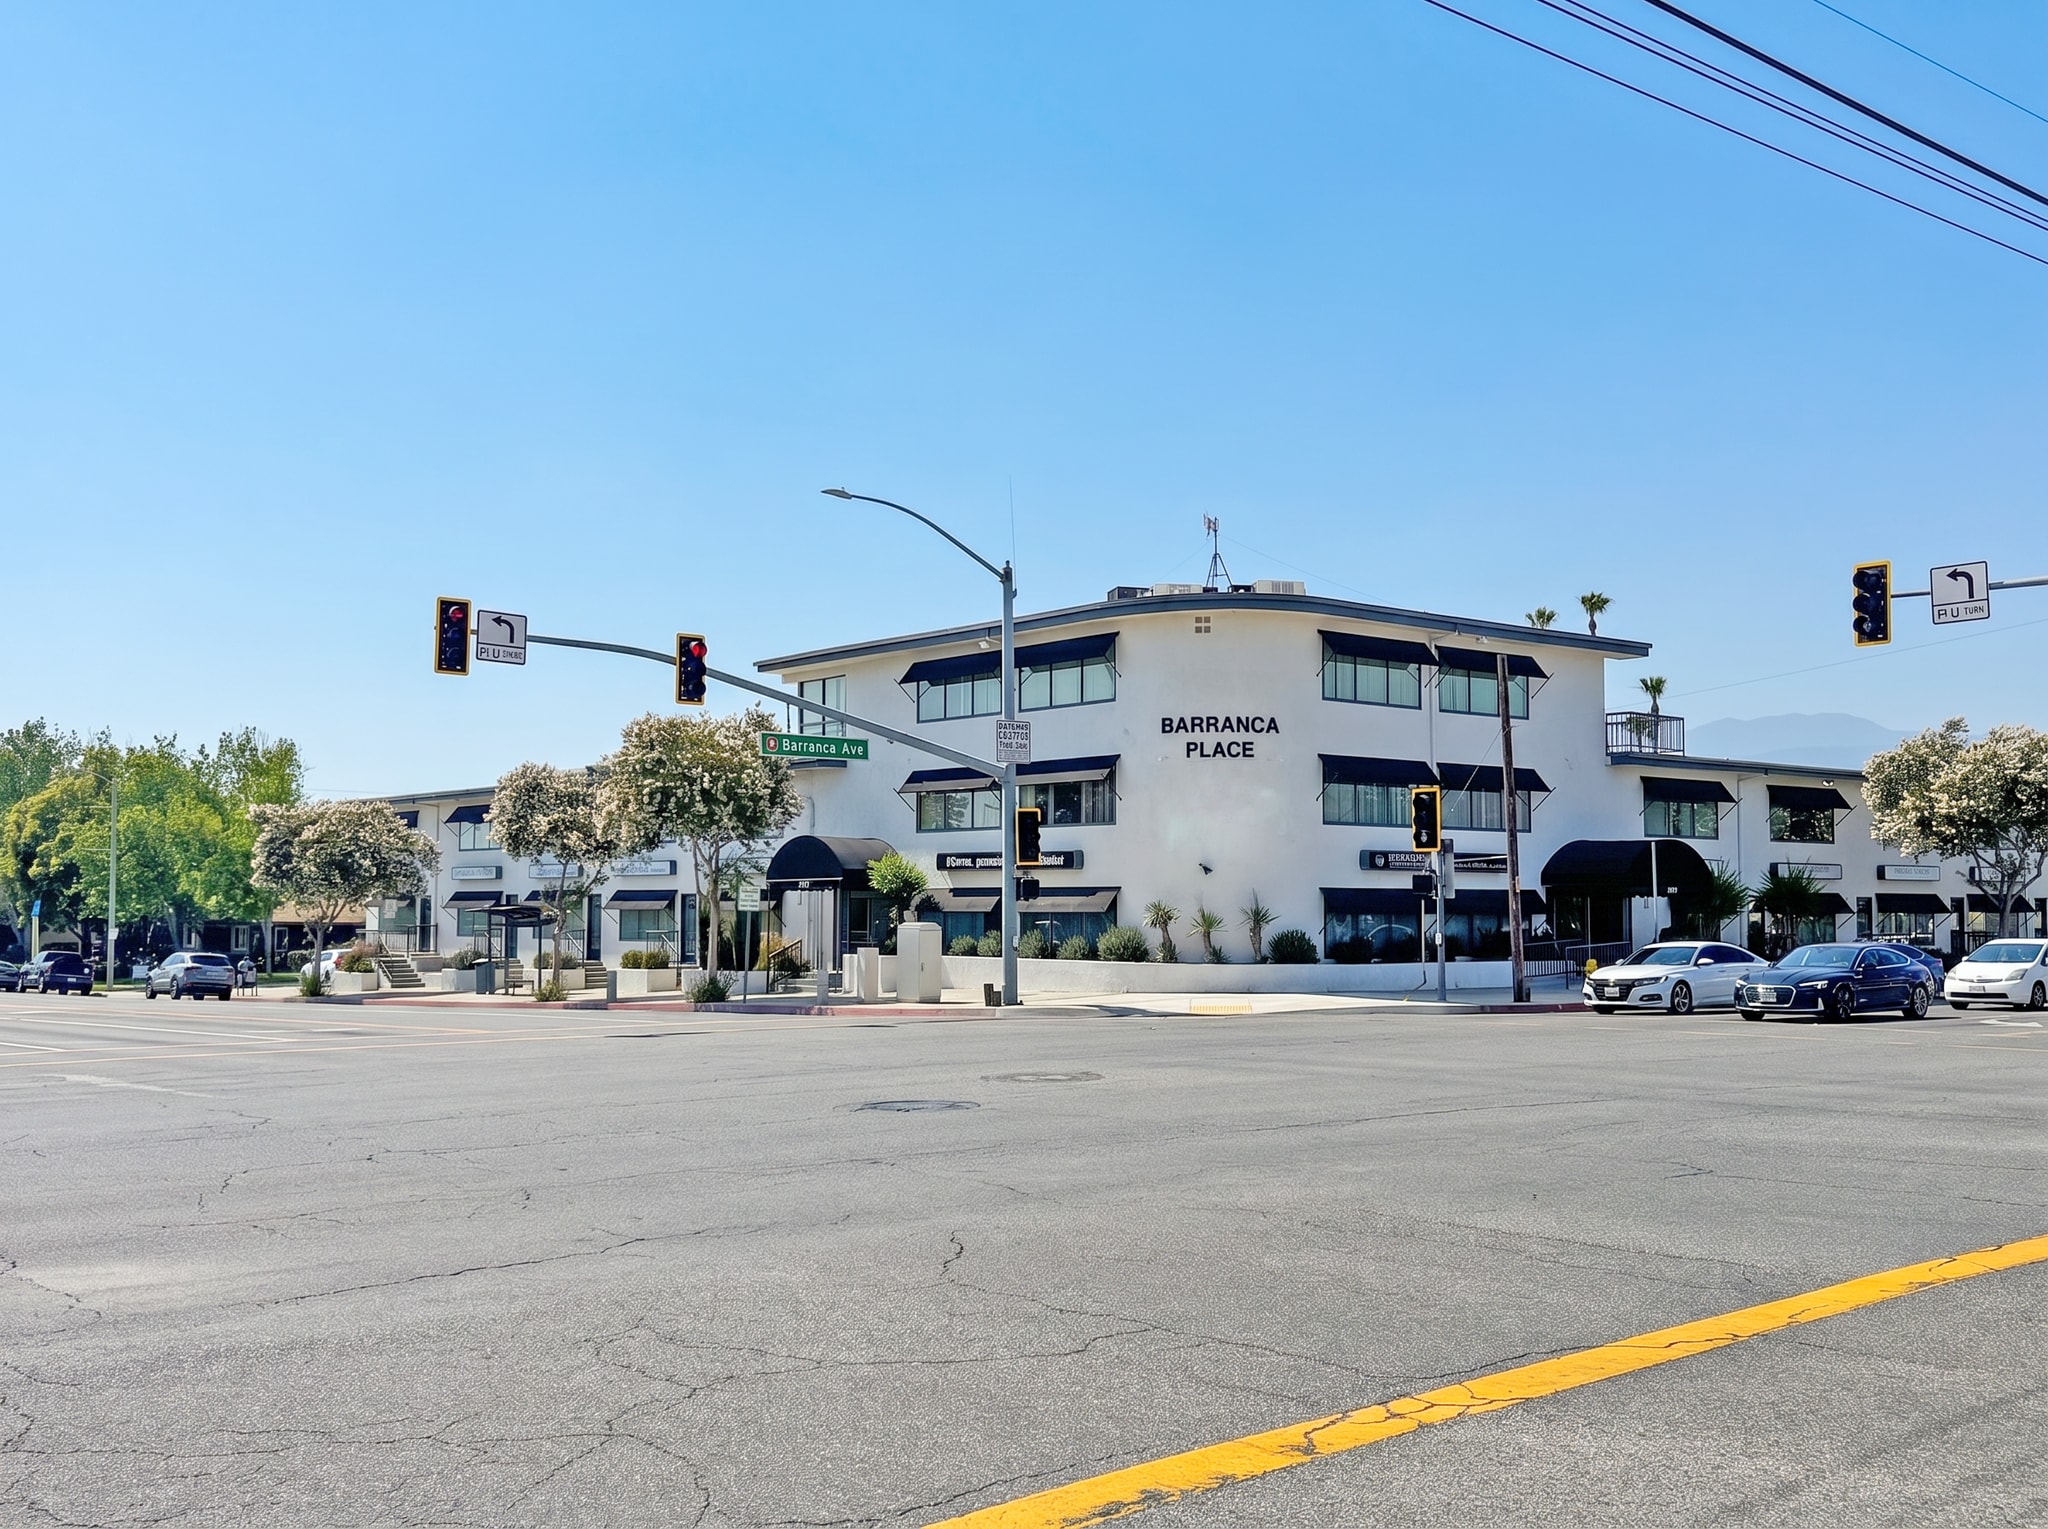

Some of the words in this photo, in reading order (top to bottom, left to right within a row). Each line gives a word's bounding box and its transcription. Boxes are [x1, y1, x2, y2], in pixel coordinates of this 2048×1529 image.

[1950, 606, 1960, 618] U
[1964, 605, 1984, 615] TURN
[1161, 715, 1280, 734] BARRANCA
[782, 738, 836, 754] Barranca
[841, 742, 864, 756] Ave
[1186, 741, 1255, 759] PLACE
